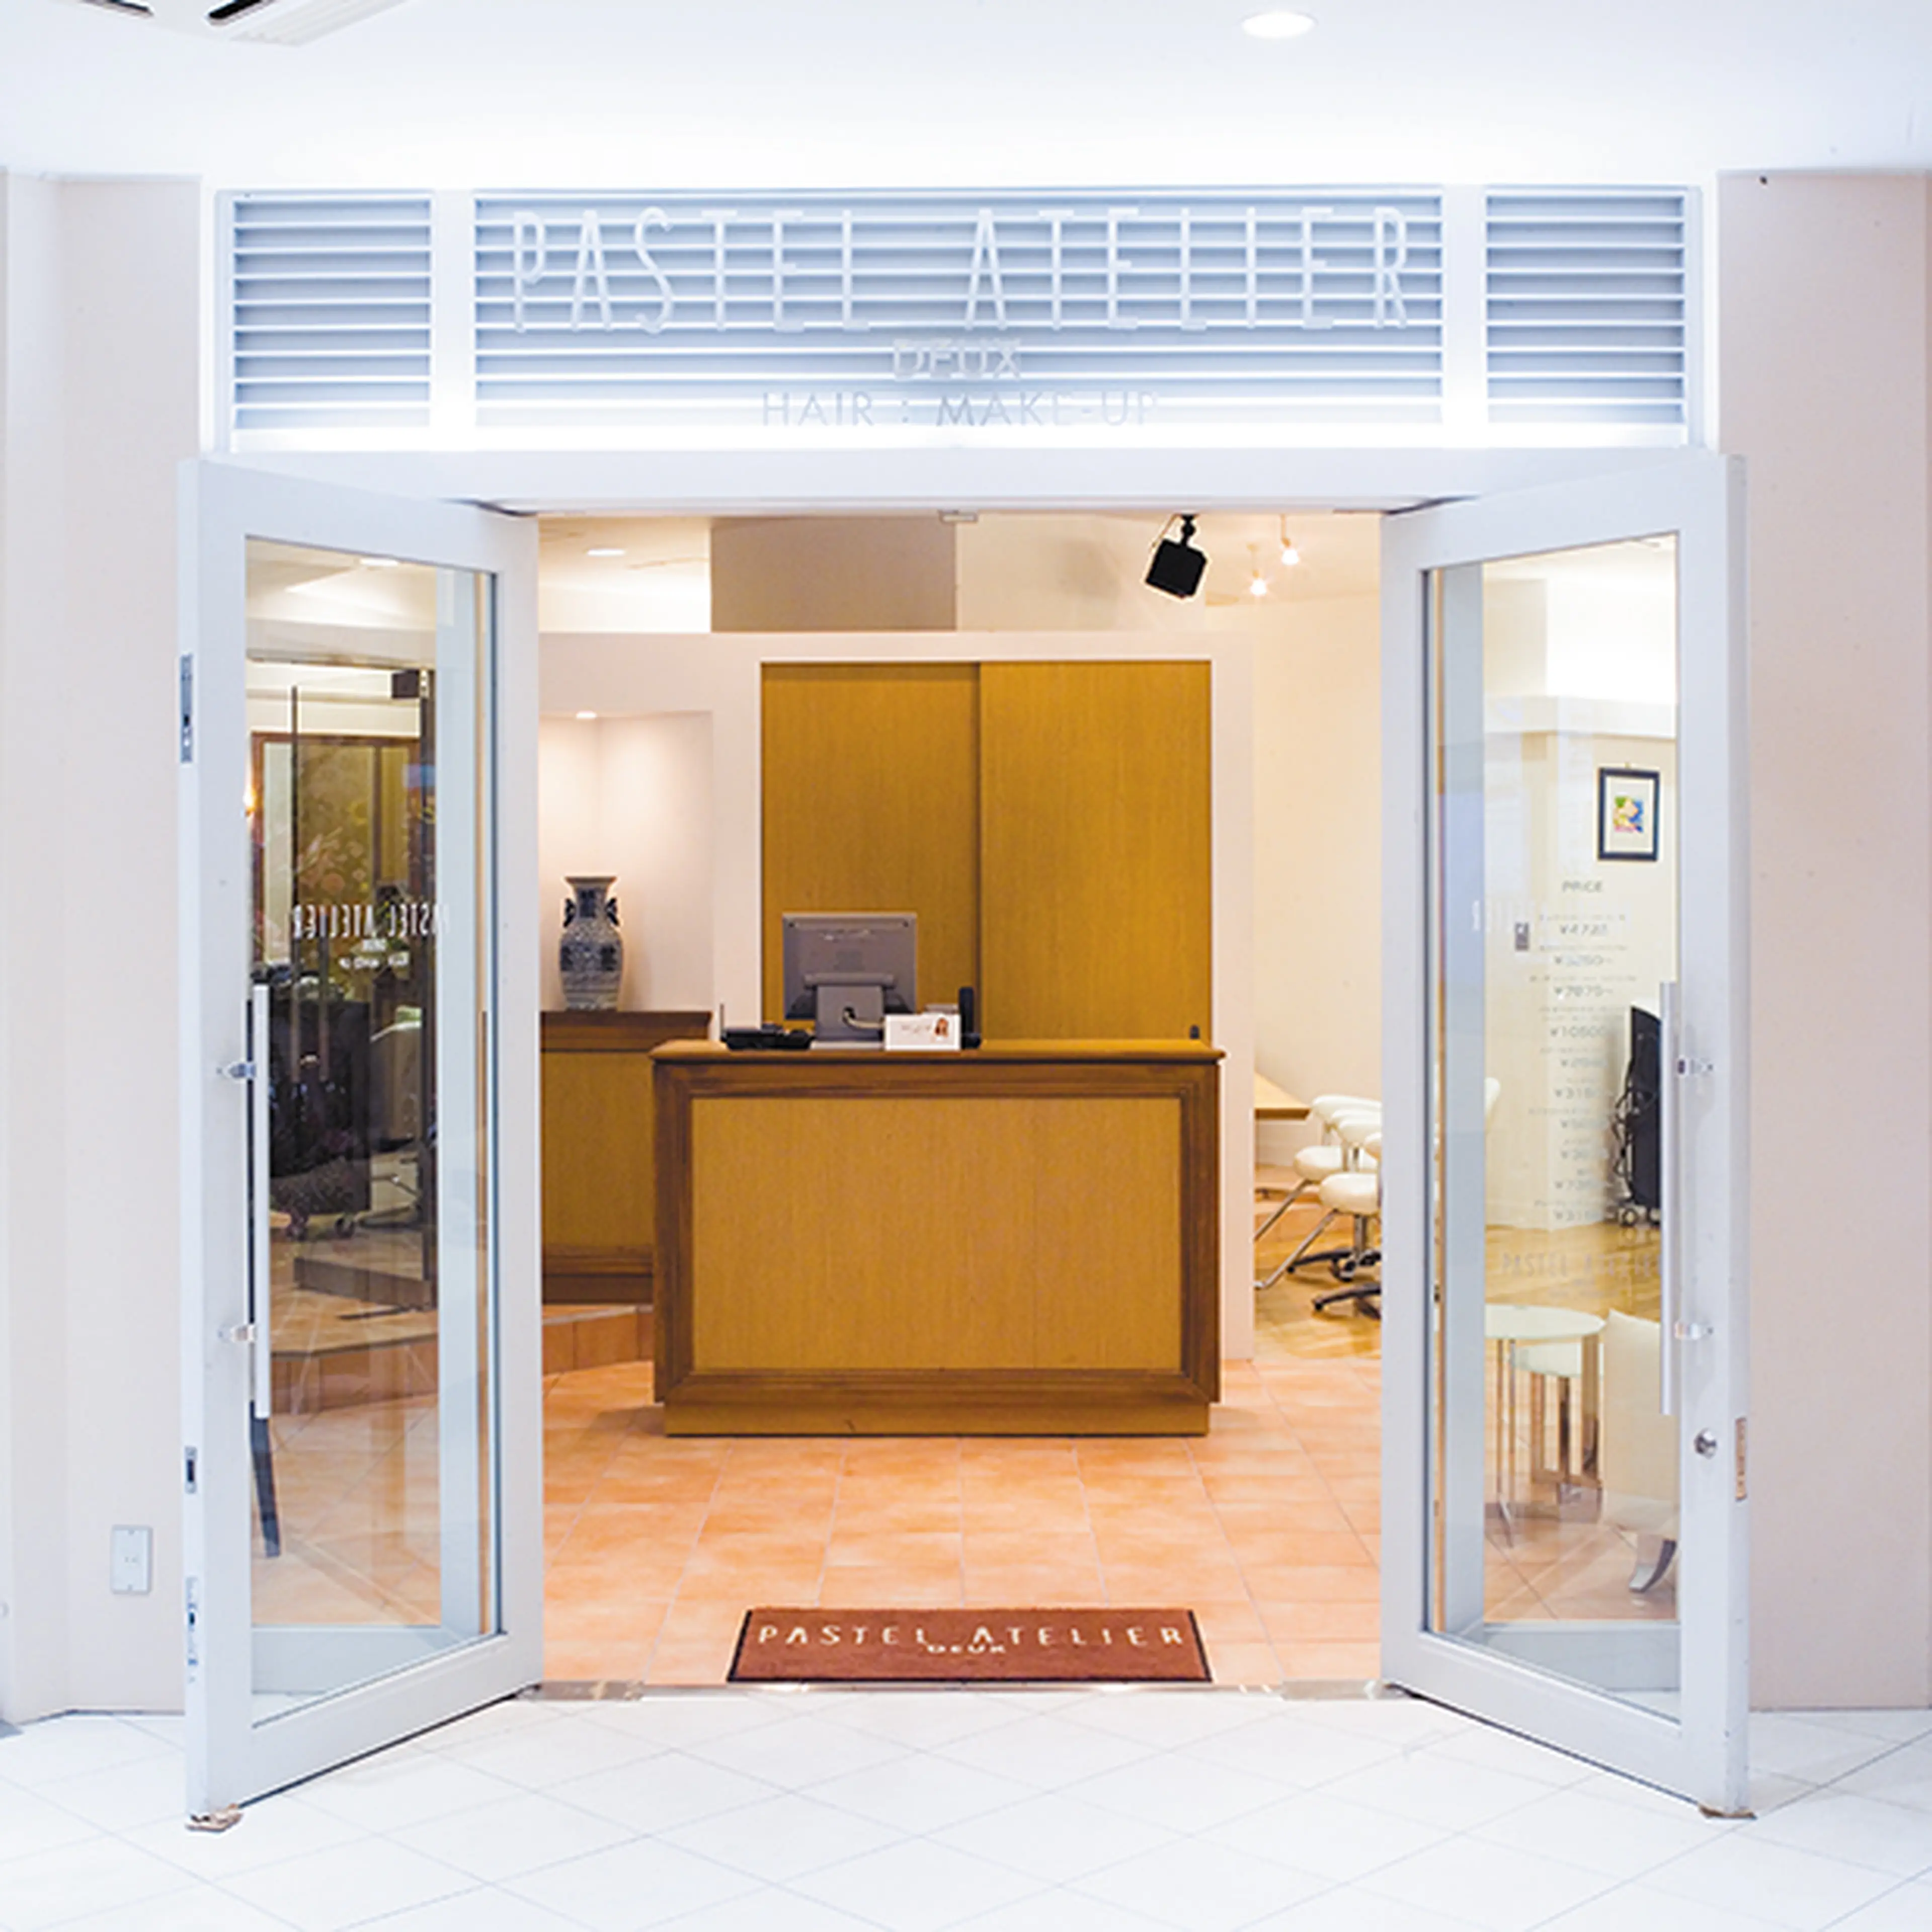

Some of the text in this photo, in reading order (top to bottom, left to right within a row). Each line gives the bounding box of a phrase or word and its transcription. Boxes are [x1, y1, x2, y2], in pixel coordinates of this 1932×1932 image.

[512, 207, 1408, 333] PASTEL ATELIER
[893, 337, 1022, 382] DEUX
[761, 390, 874, 427] HAIR
[936, 390, 1159, 427] MAKE-UP
[758, 1625, 1184, 1646] PASTEL ATELIER
